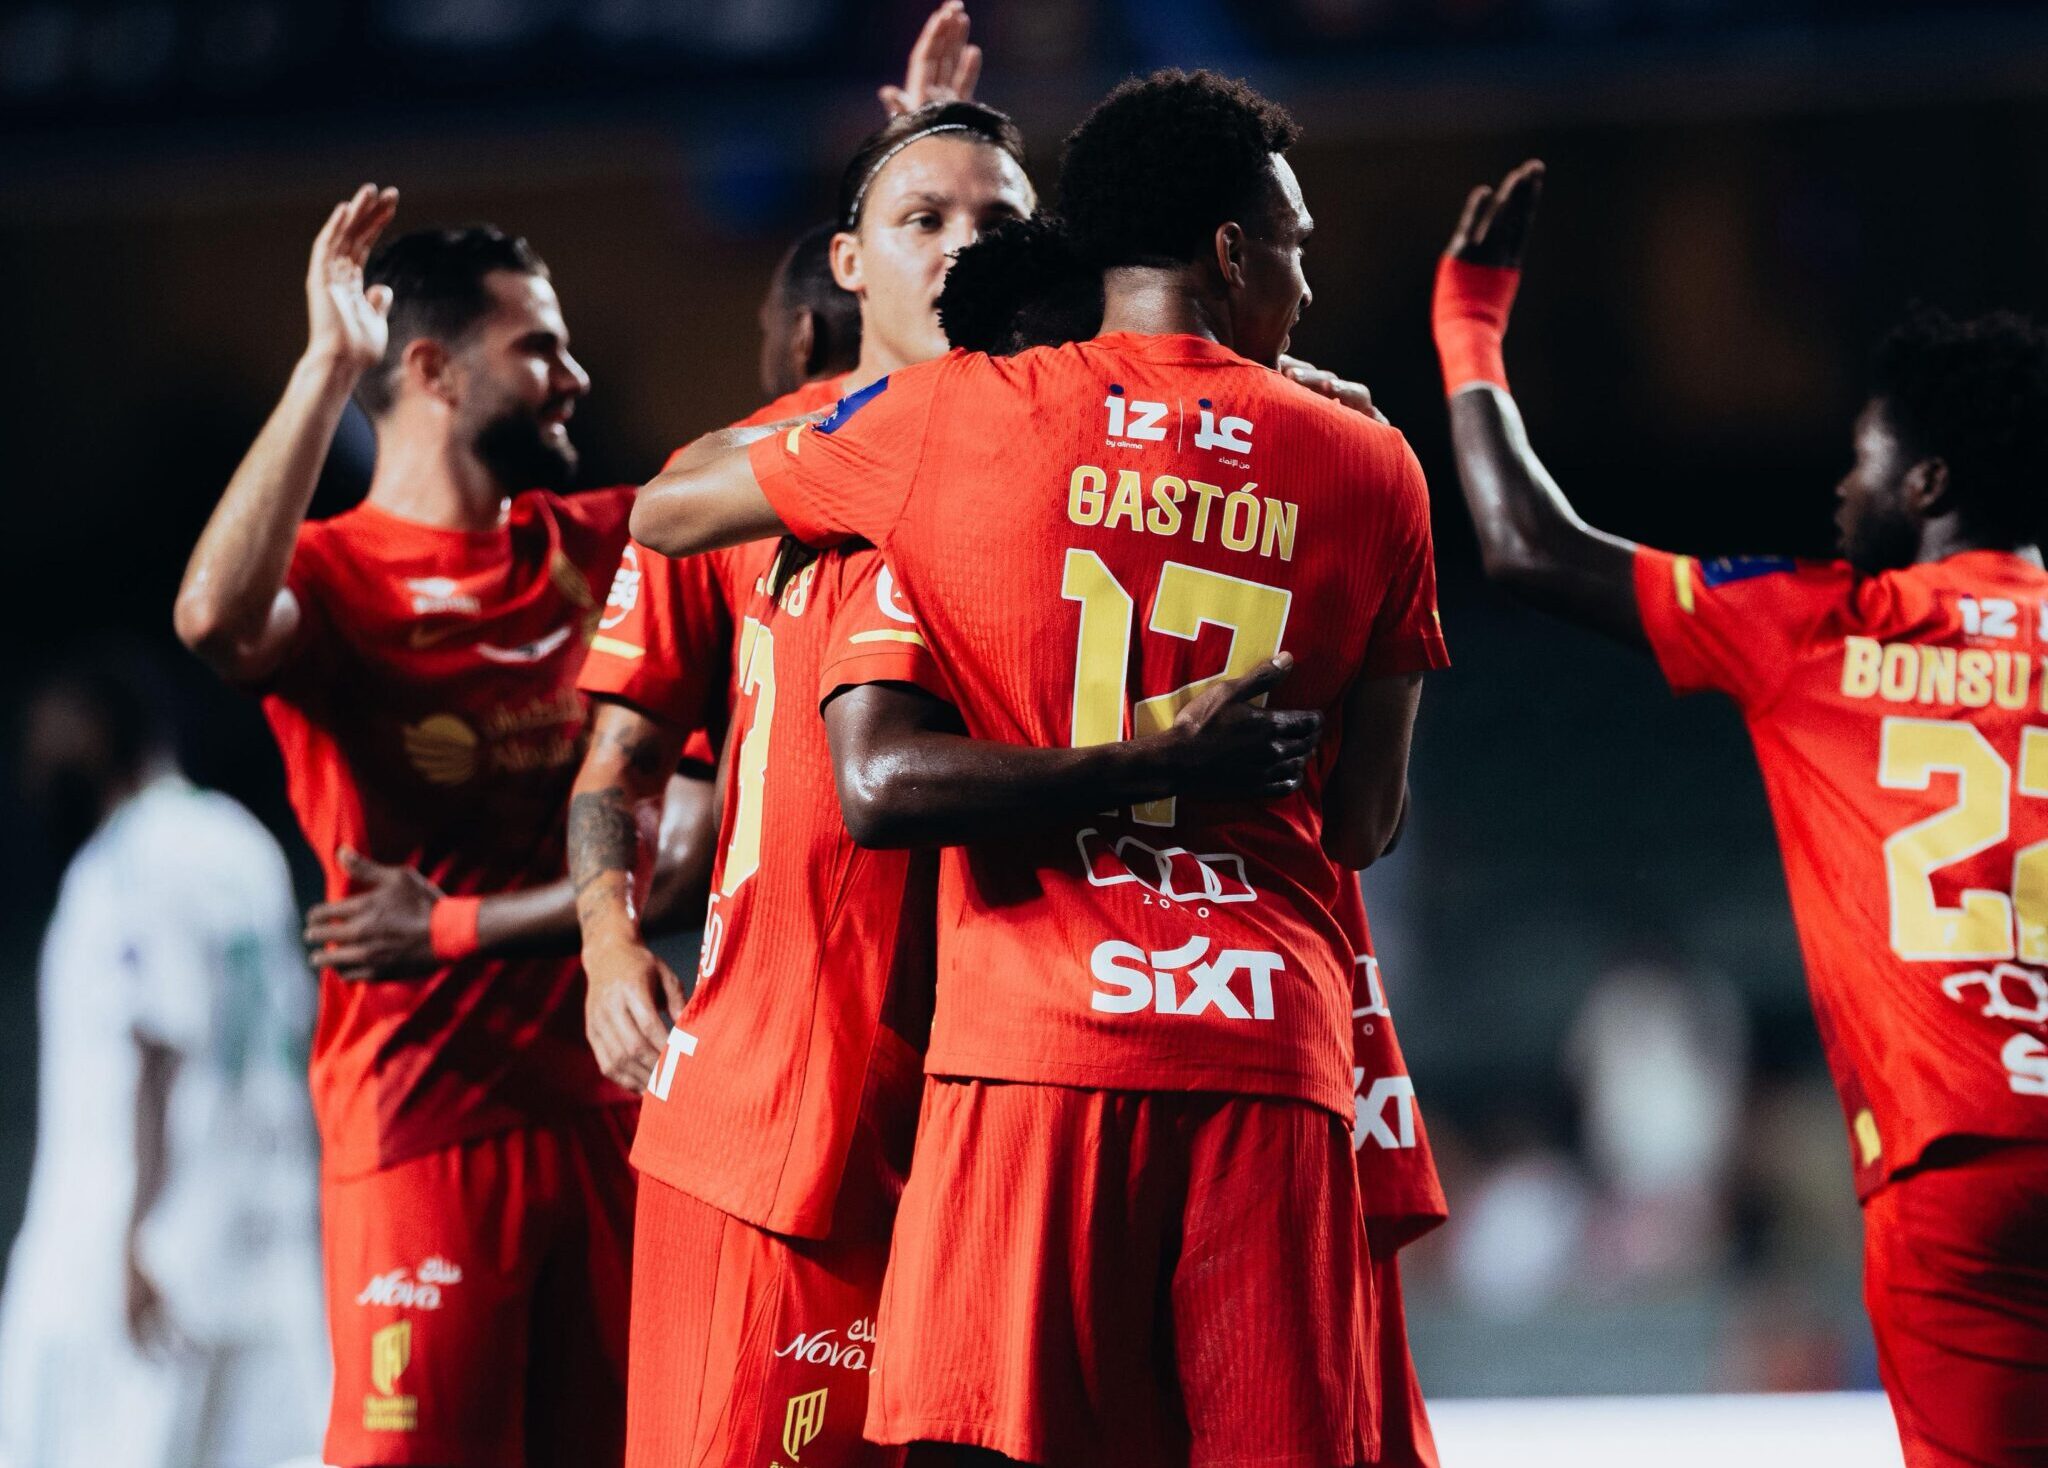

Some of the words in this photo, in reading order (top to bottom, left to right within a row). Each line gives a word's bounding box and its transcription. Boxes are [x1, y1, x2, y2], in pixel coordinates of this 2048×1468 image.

[1105, 438, 1116, 448] by
[1067, 465, 1299, 562] GASTÓN
[1061, 547, 1293, 828] 17
[1841, 634, 2031, 711] BONSU
[1877, 715, 2048, 966] 2
[1142, 893, 1210, 919] ZOO
[774, 1328, 868, 1370] Nova
